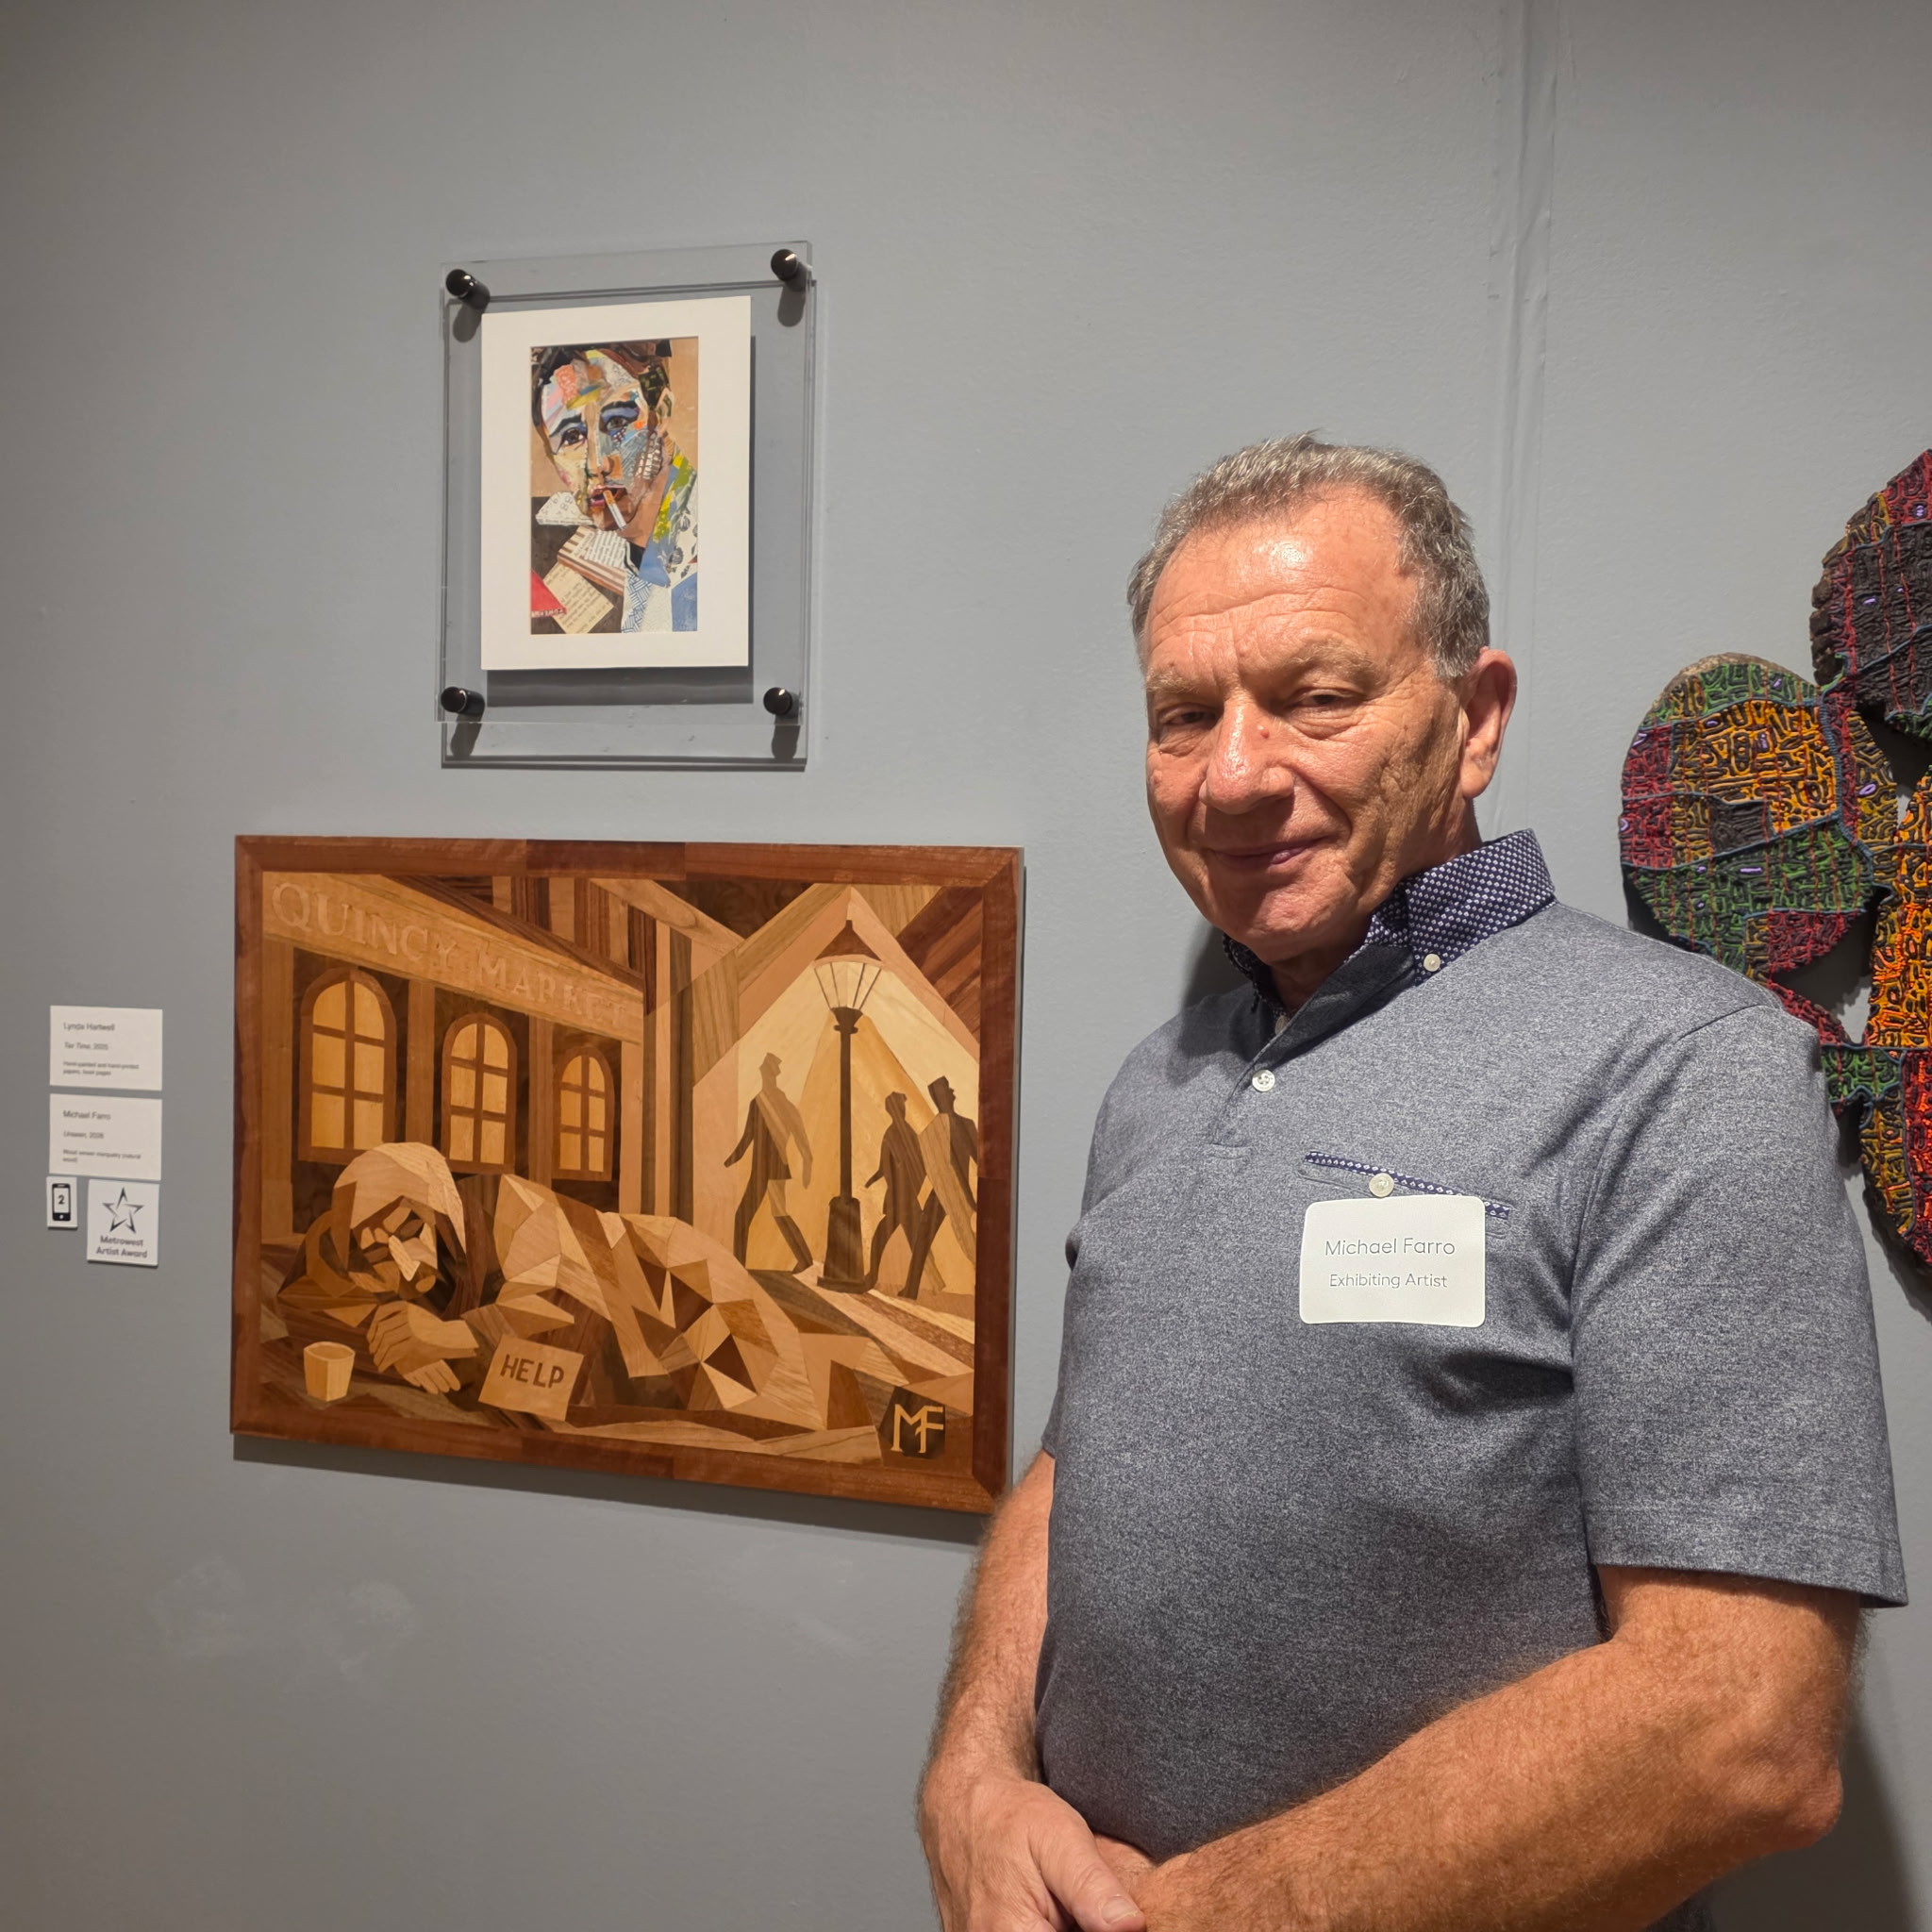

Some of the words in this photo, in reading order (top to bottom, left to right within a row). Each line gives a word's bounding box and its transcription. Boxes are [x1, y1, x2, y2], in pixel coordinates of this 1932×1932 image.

[271, 881, 458, 969] QUINCY
[475, 945, 628, 1026] MARKET
[63, 1110, 91, 1119] Michael
[92, 1111, 111, 1120] Farro
[58, 1194, 65, 1205] 2
[100, 1235, 143, 1246] Metrowest
[1324, 1238, 1397, 1256] Michael
[1403, 1238, 1456, 1255] Farro
[96, 1246, 119, 1256] Artist
[121, 1248, 148, 1258] Award
[1329, 1274, 1401, 1289] Exhibiting
[1405, 1273, 1448, 1288] Artist
[500, 1353, 565, 1389] HELP
